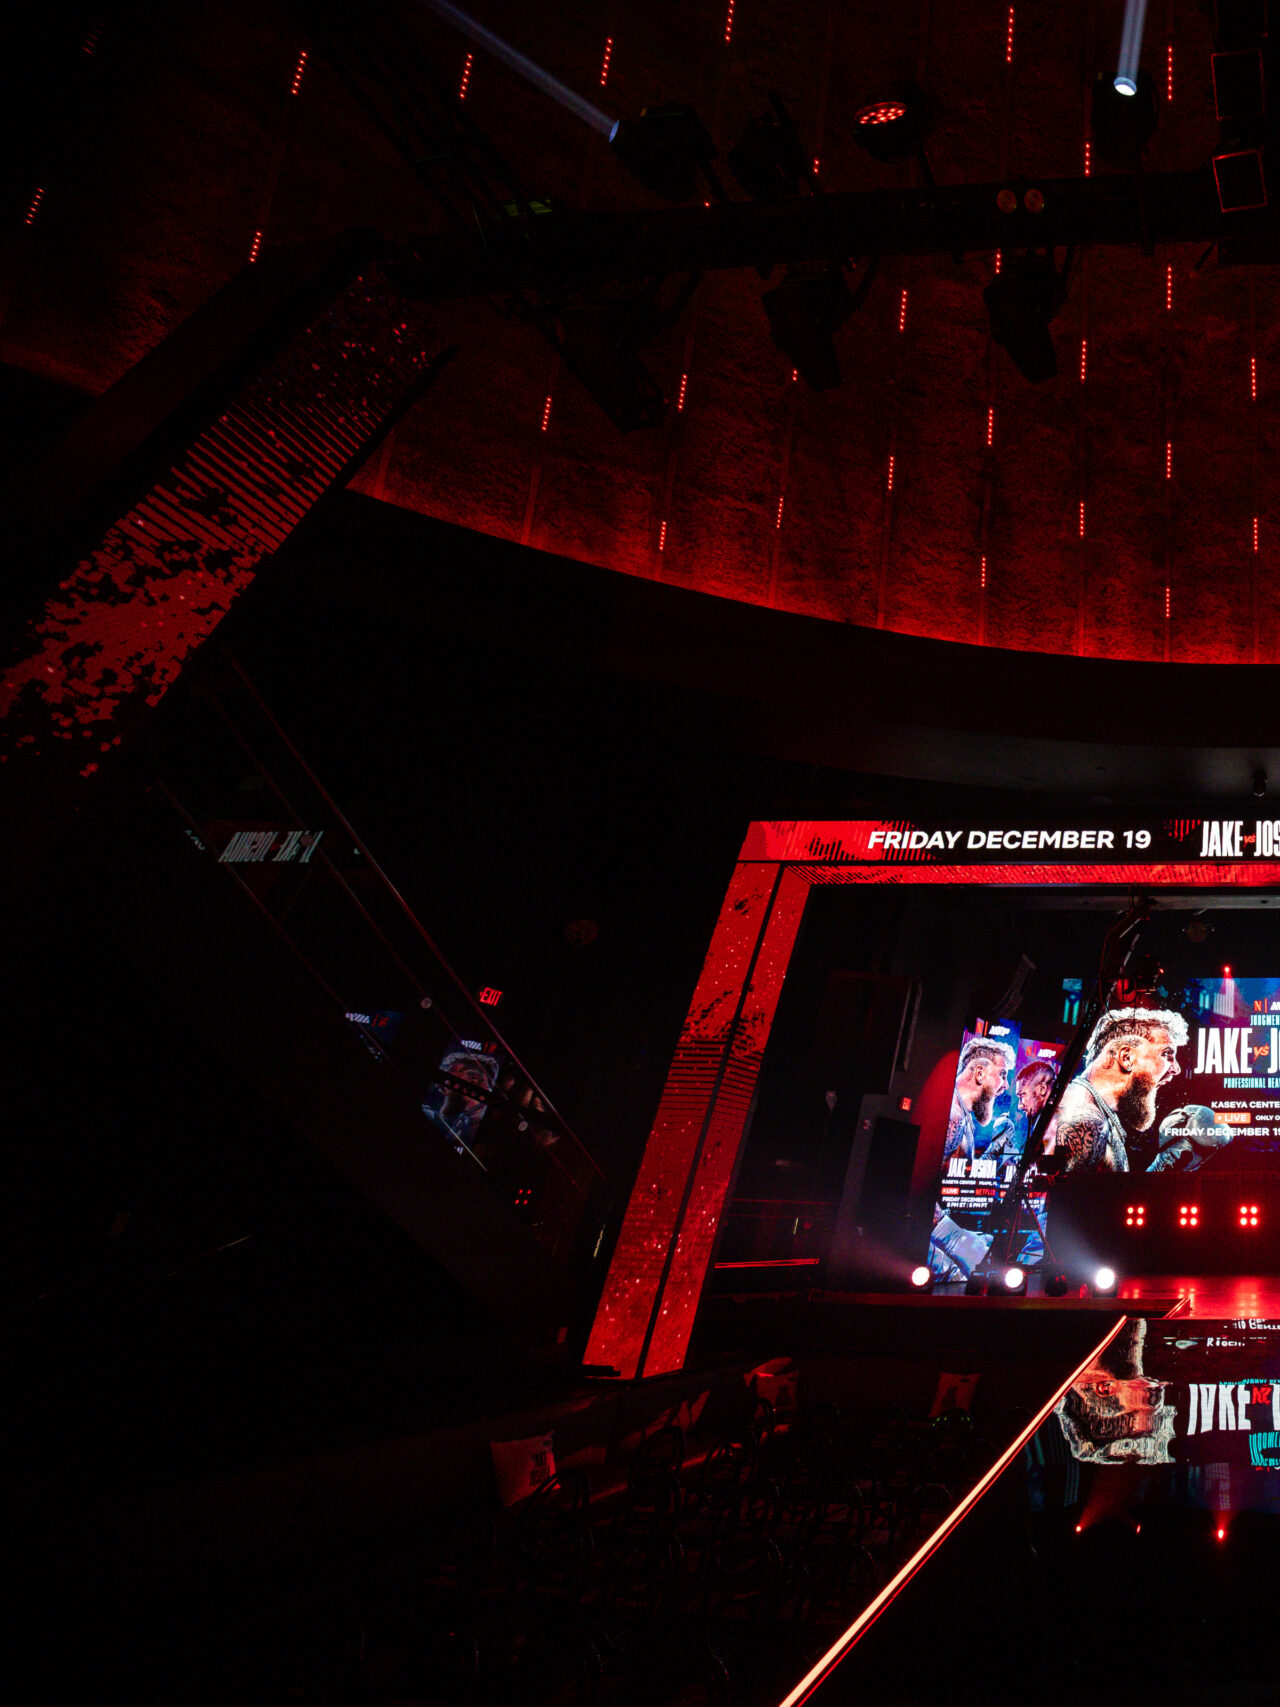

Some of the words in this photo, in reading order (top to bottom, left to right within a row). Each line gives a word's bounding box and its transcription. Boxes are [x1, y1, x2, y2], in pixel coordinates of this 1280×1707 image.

[868, 830, 963, 849] FRIDAY
[967, 830, 1115, 849] DECEMBER
[1123, 830, 1151, 849] 19
[1200, 820, 1243, 857] JAKE
[479, 986, 503, 1006] EXIT
[1194, 1027, 1252, 1074] JAKE
[1223, 1077, 1266, 1088] PROFESSIONAL
[1211, 1101, 1247, 1109] KASEYA
[1224, 1114, 1247, 1122] LIVE
[1165, 1127, 1205, 1137] FRIDAY
[1206, 1127, 1270, 1137] DECEMBER
[947, 1158, 968, 1178] JAKE
